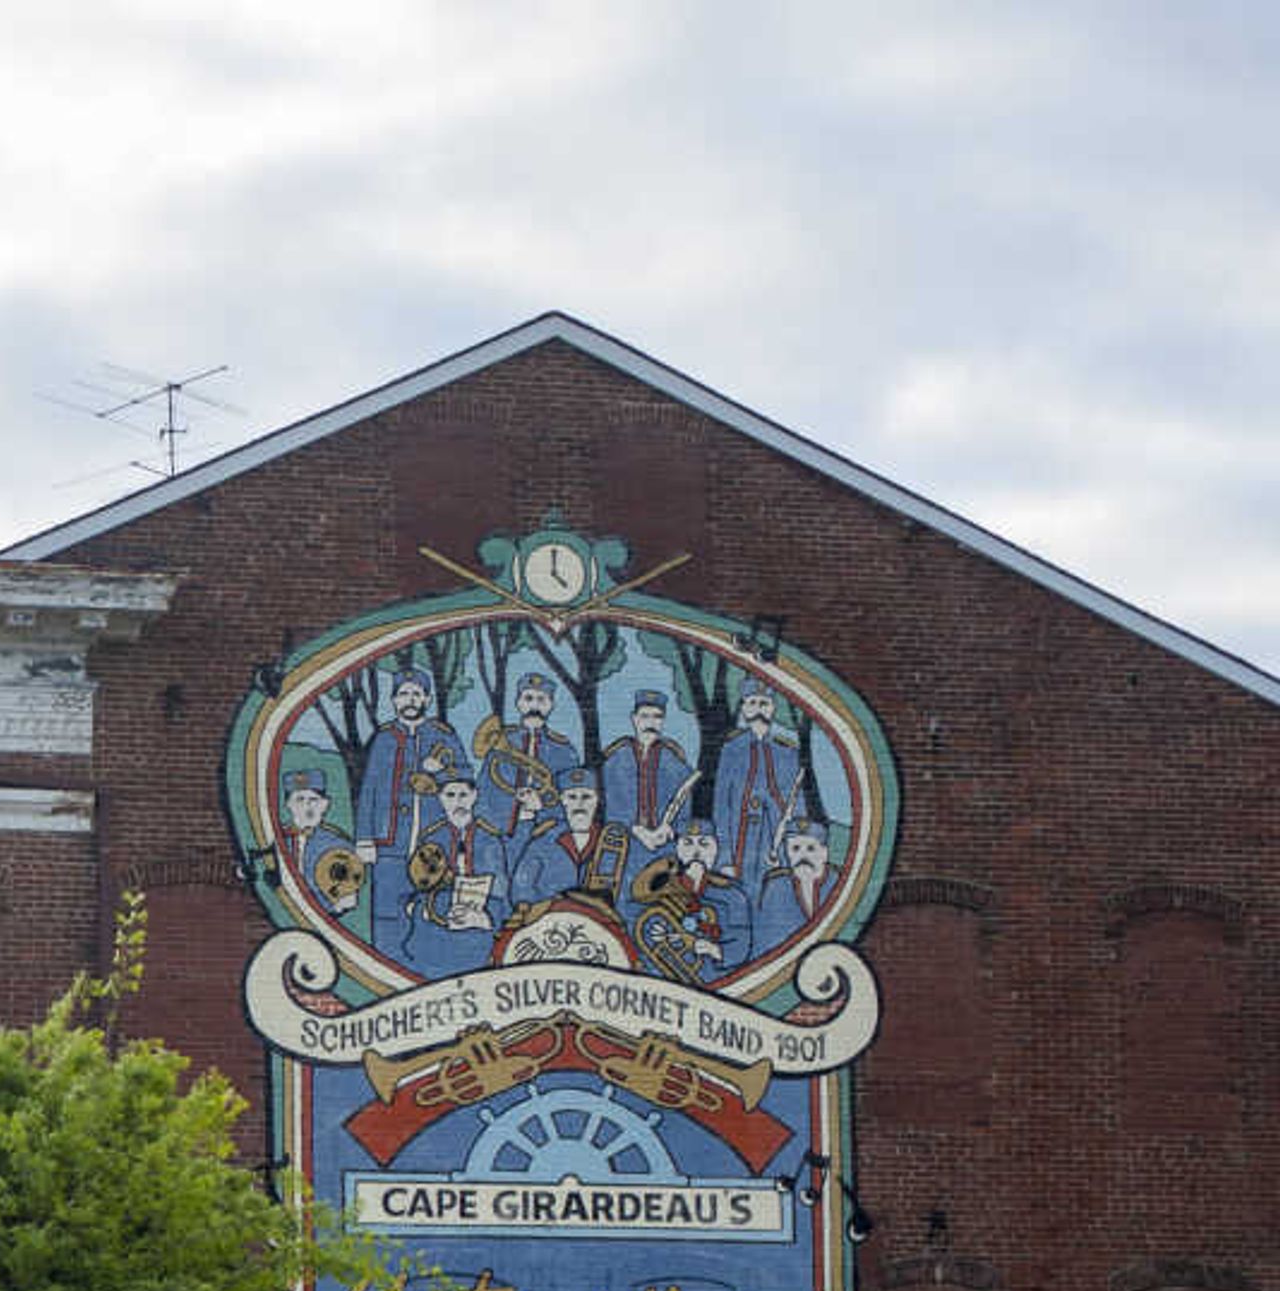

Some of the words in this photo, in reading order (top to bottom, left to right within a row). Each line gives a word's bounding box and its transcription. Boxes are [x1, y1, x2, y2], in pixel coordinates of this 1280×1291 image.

[300, 979, 479, 1052] SCHUCHERT'S
[494, 979, 581, 1014] SILVER
[588, 981, 689, 1029] CORNET
[698, 1010, 763, 1055] BAND
[774, 1033, 827, 1063] 1901
[381, 1187, 478, 1219] CAPE
[492, 1189, 753, 1225] GIRARDEAU'S
